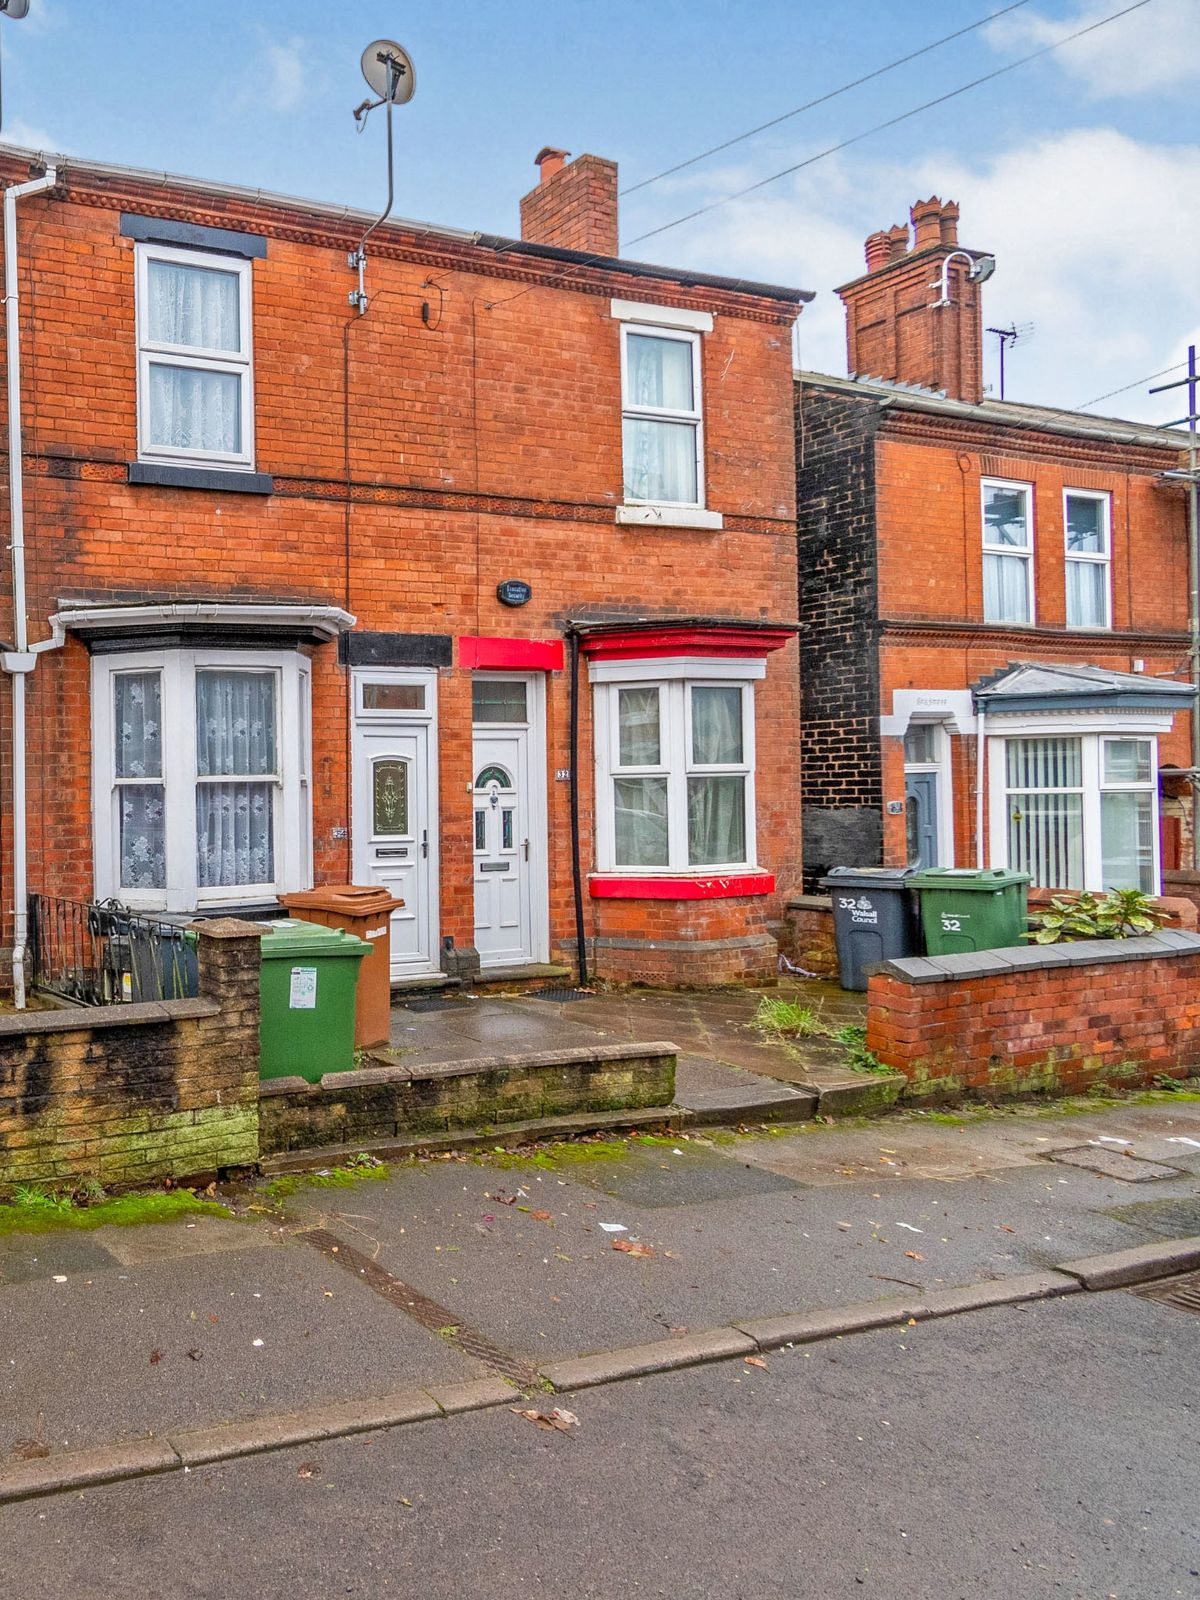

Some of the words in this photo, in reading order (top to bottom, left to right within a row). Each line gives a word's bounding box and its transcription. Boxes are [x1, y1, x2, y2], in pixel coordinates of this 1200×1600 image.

[838, 897, 856, 909] 32
[852, 910, 878, 918] Walsall
[851, 916, 878, 924] Council
[941, 919, 961, 931] 32
